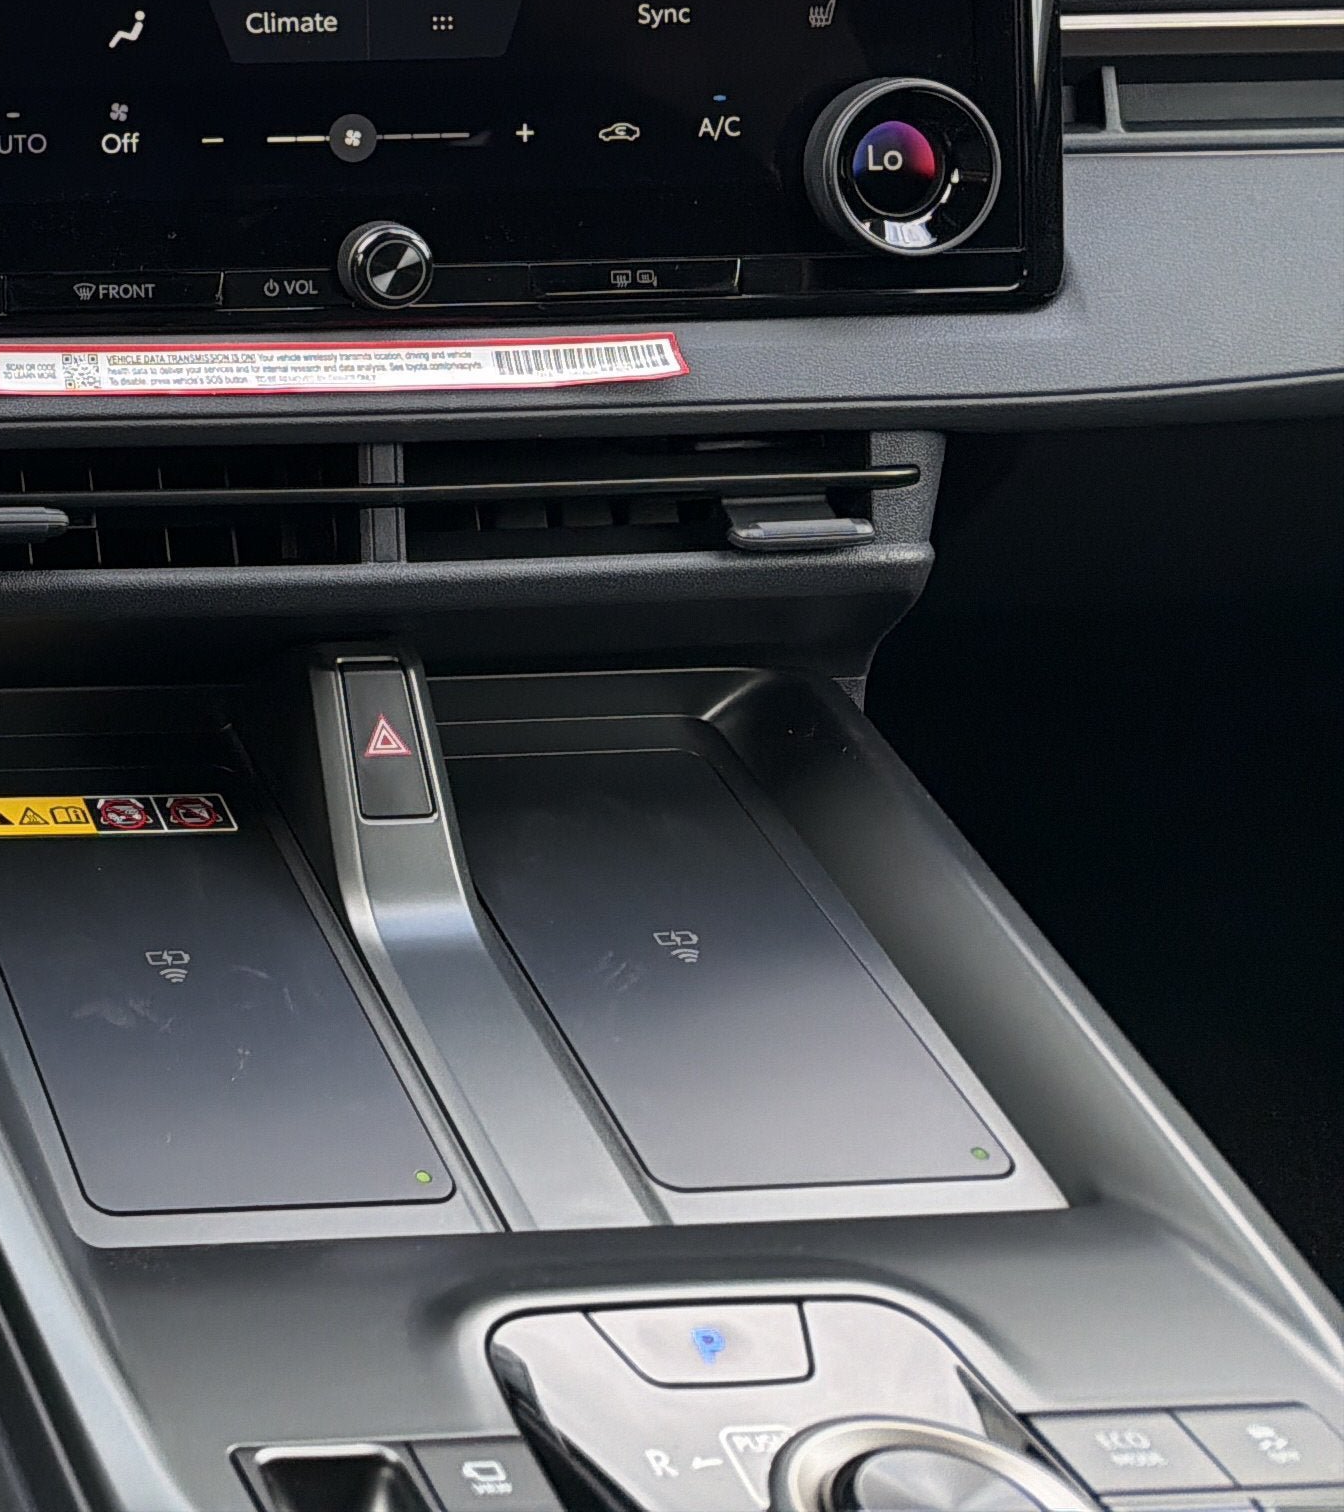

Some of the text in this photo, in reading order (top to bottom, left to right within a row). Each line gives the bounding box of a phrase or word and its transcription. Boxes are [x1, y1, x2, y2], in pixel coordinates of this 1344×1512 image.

[245, 11, 338, 34] Climate
[638, 2, 691, 29] Sync
[698, 116, 741, 140] A/C
[101, 131, 141, 155] Off
[867, 144, 903, 172] Lo
[98, 283, 156, 300] FRONT
[283, 280, 319, 296] VOL
[645, 1448, 679, 1478] R
